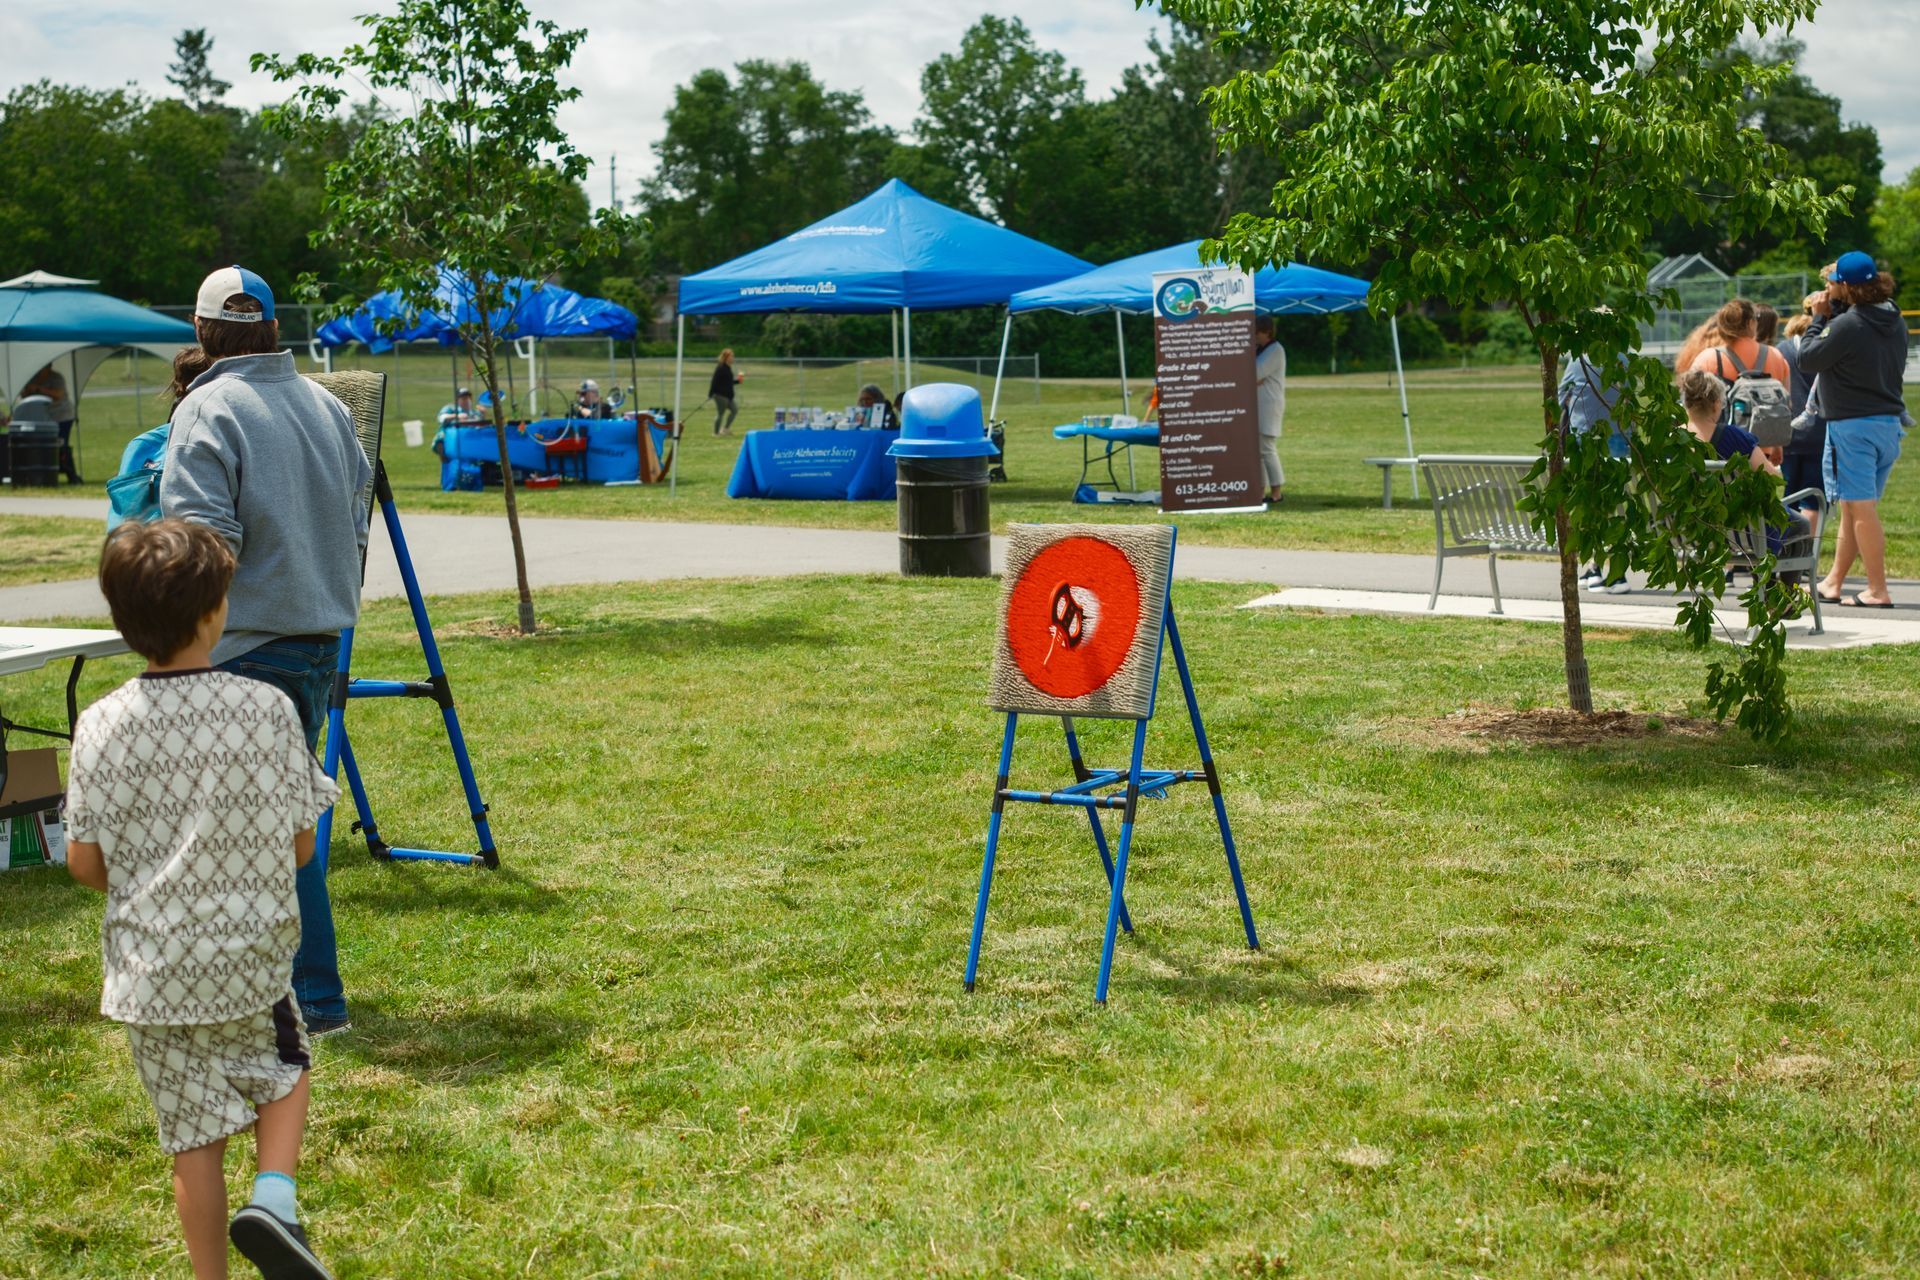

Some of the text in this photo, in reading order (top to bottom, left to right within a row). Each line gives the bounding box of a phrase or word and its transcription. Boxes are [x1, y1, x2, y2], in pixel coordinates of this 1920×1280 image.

[223, 312, 256, 320] NEWFOUNDLAND
[1180, 363, 1186, 371] 2
[1186, 362, 1200, 370] and
[1170, 434, 1183, 442] and
[1175, 480, 1248, 495] 613-542-0400
